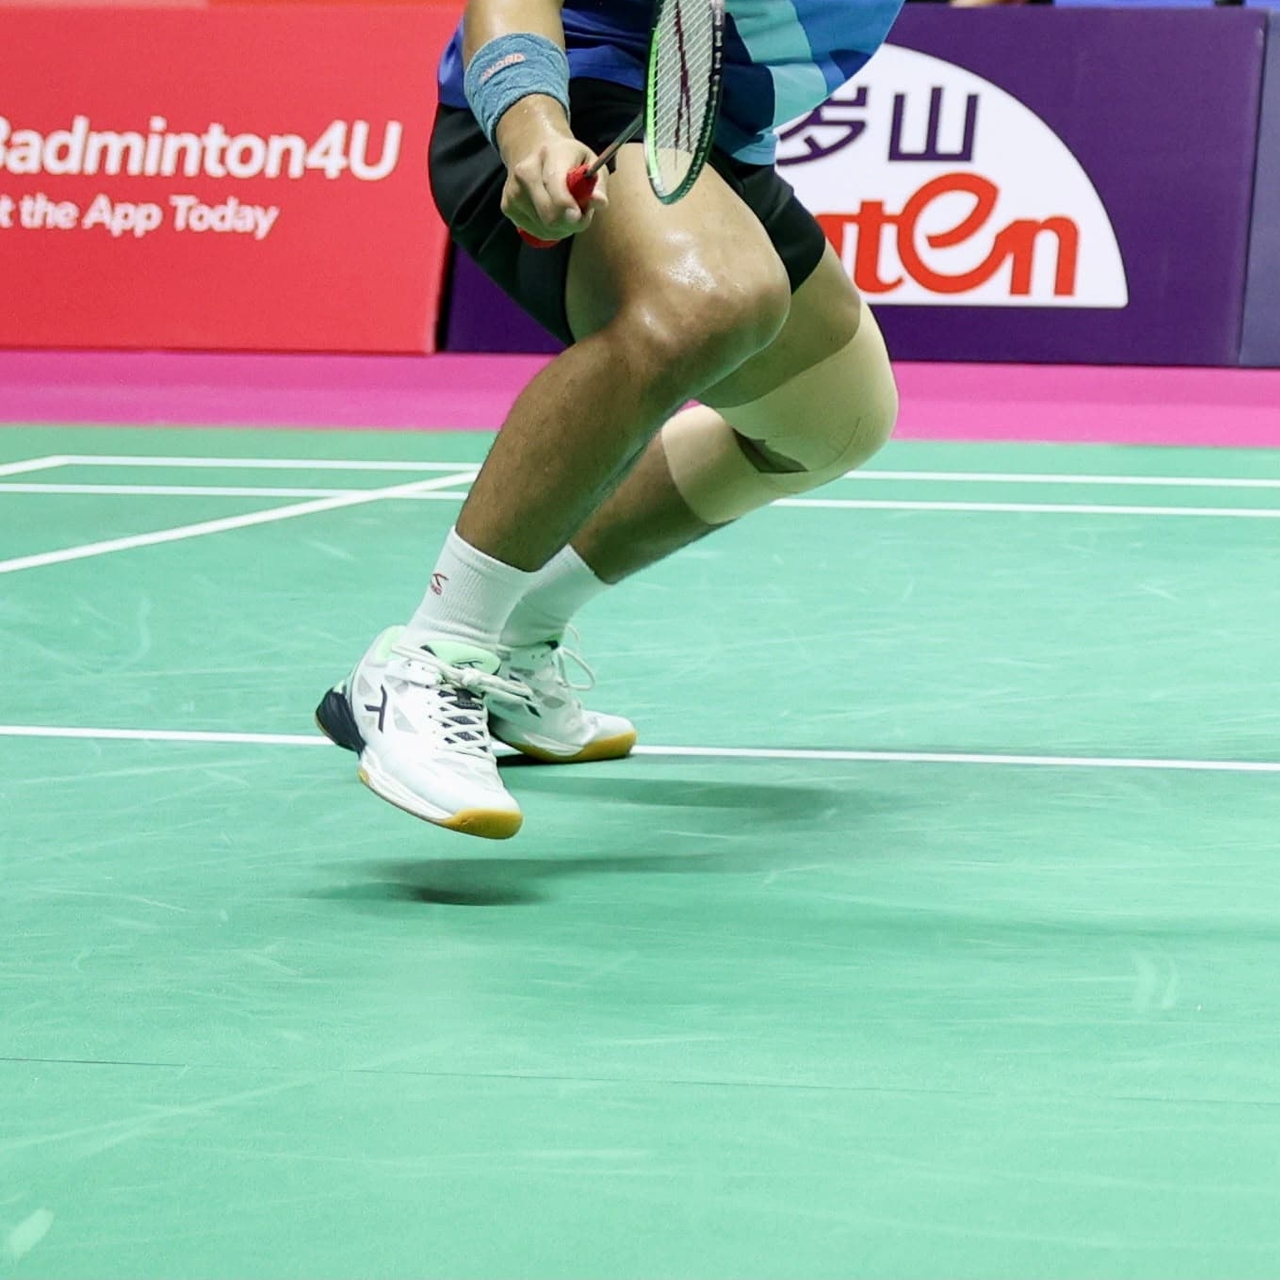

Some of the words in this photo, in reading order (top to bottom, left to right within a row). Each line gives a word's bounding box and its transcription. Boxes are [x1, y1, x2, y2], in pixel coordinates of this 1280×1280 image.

[776, 87, 980, 167] 岁山
[20, 192, 79, 229] the
[82, 194, 162, 237] App
[169, 194, 279, 240] Today
